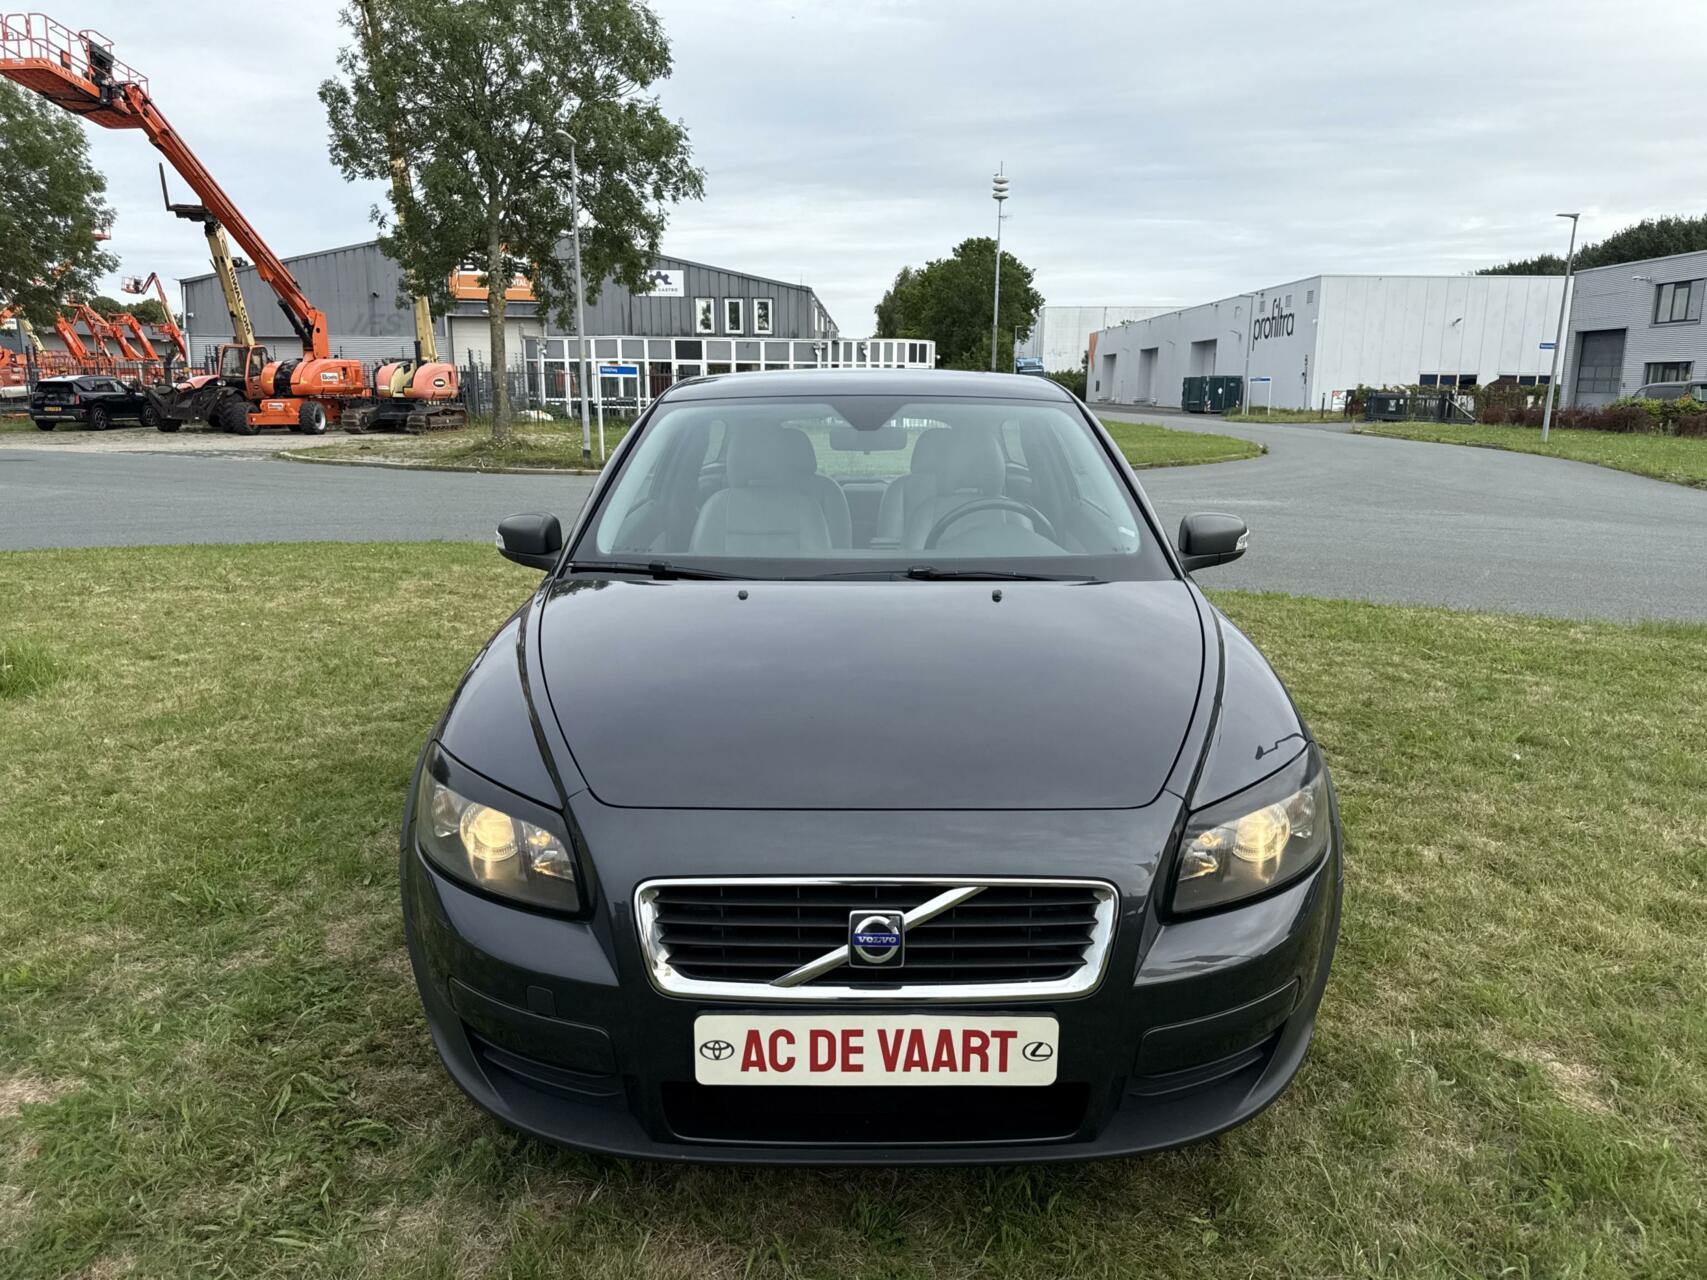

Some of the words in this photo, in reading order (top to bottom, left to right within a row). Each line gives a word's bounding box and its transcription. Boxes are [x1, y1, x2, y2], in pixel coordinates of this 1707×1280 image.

[1252, 297, 1295, 352] profiltra
[857, 936, 897, 944] VOLVO
[740, 1028, 795, 1073] AC
[809, 1028, 864, 1073] DE
[877, 1028, 1018, 1073] VAART
